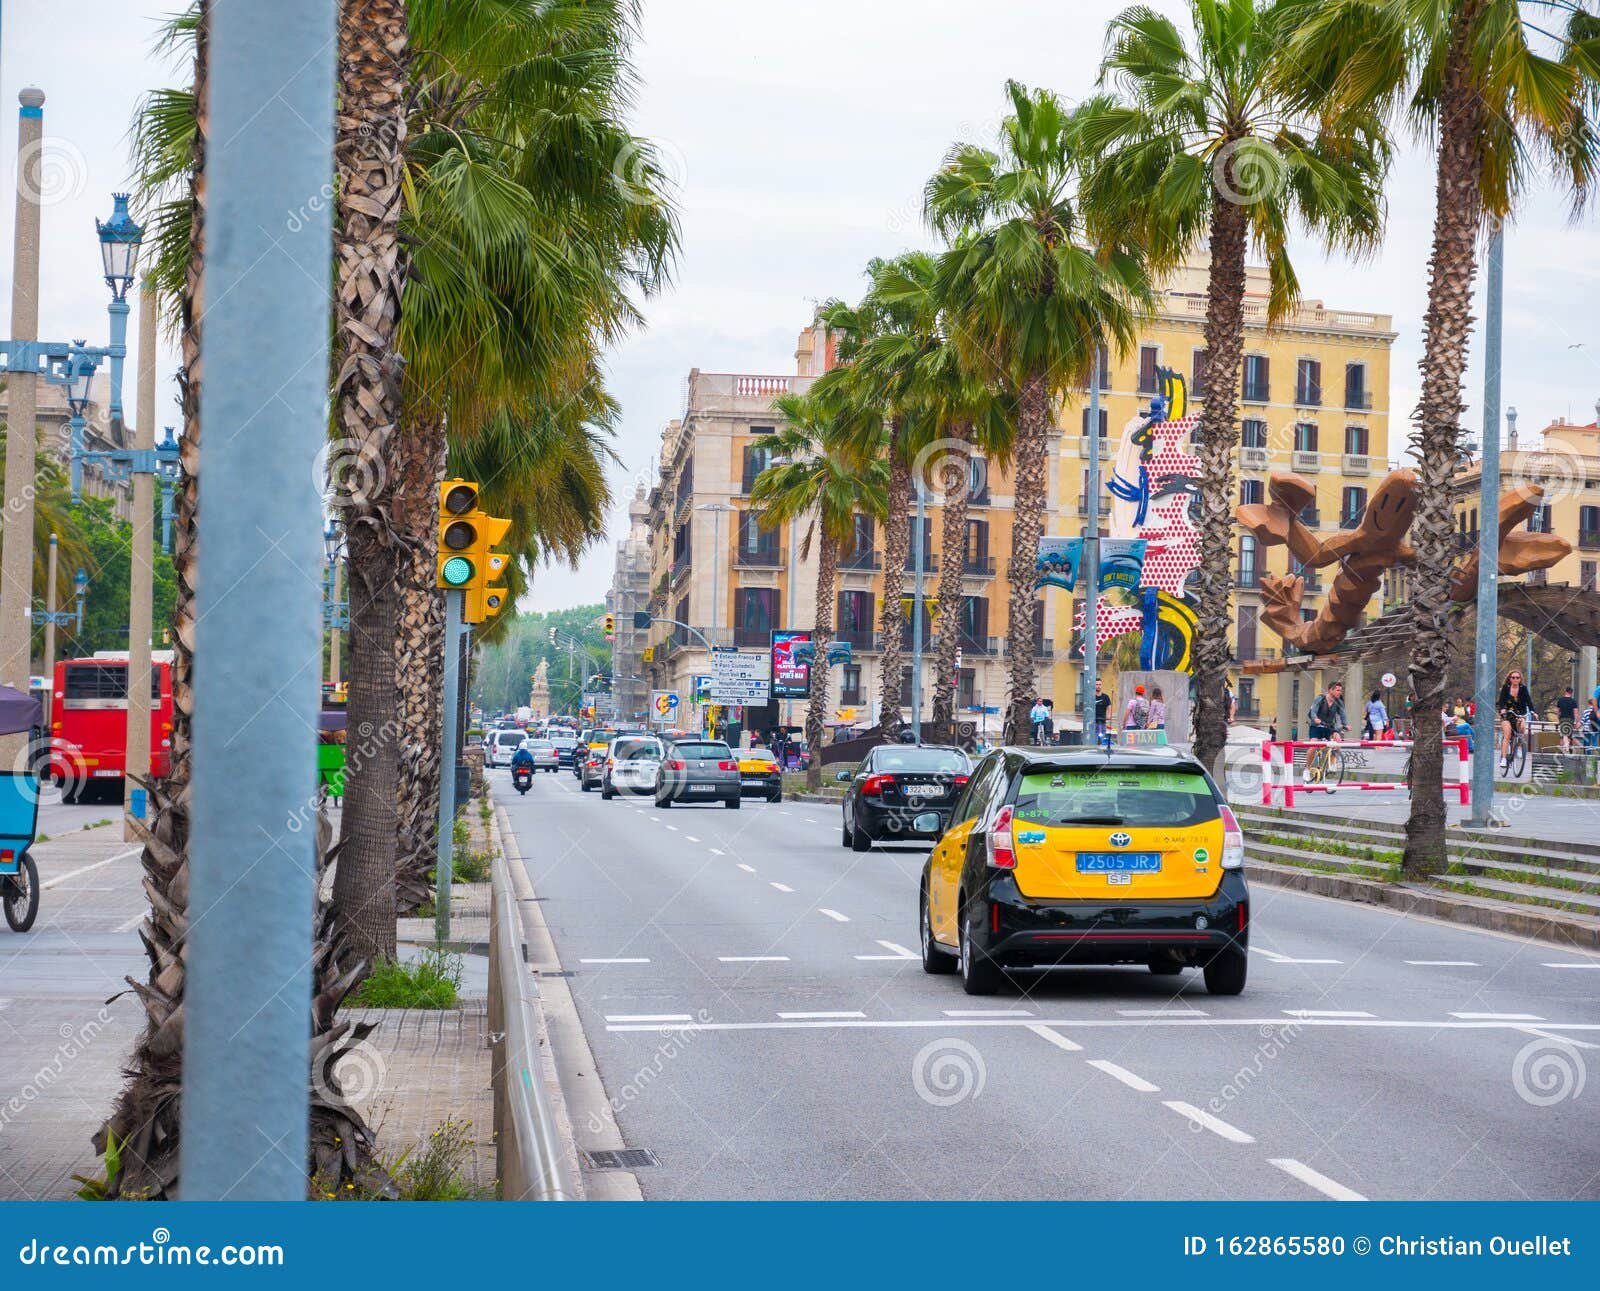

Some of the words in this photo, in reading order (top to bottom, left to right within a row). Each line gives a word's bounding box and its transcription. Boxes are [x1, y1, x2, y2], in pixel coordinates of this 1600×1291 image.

[1088, 857, 1125, 869] 2505
[1131, 857, 1159, 870] JRJ
[1109, 874, 1129, 884] SP
